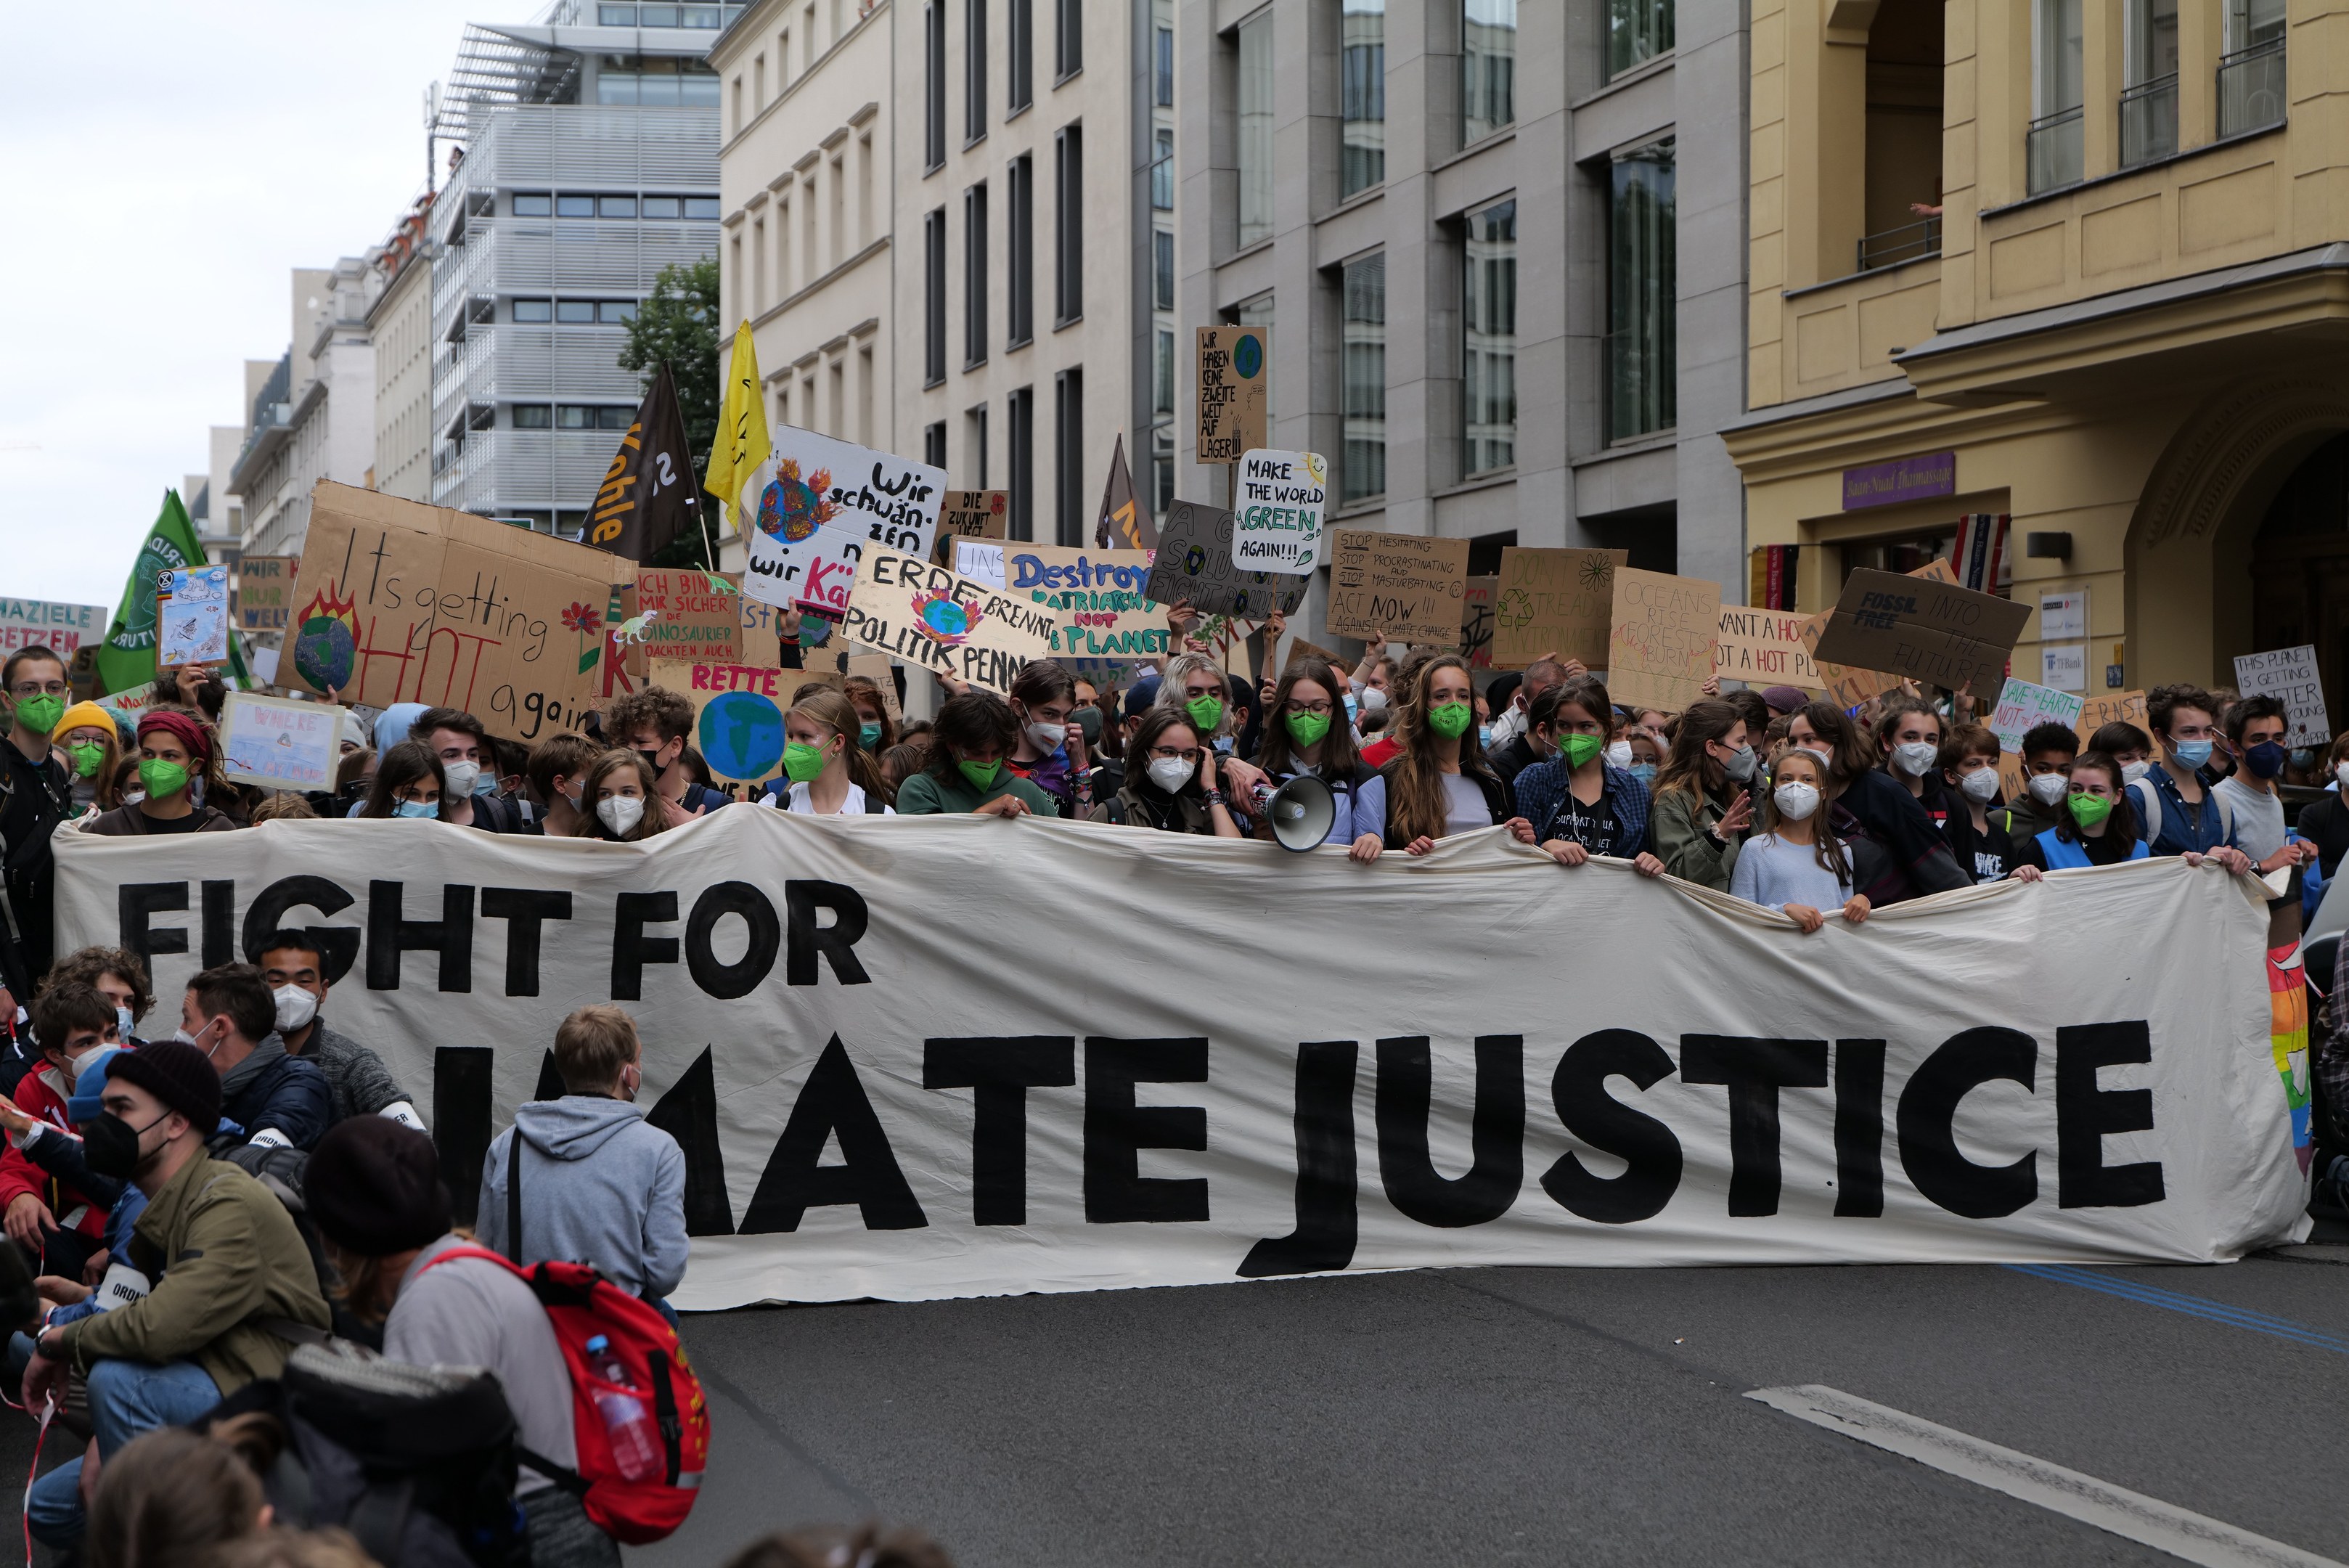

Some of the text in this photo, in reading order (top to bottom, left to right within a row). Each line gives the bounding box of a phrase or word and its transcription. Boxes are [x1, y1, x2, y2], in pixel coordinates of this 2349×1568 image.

[1202, 332, 1217, 348] WIR
[1202, 350, 1229, 369] HABEN
[1202, 369, 1223, 386] KEINE
[1202, 385, 1235, 402] ZWEITE
[1202, 403, 1225, 419] WELT
[1201, 419, 1219, 436] AUF
[1200, 437, 1241, 461] LAGER!!!
[1247, 459, 1291, 480] MAKE
[1846, 466, 1952, 497] Baan-Nuad Thaimassage
[872, 462, 934, 502] Wir
[1246, 482, 1323, 505] THE WORLD
[963, 492, 982, 509] DIE
[949, 511, 990, 525] ZUKUNFT
[1167, 505, 1194, 536] A
[1245, 505, 1315, 531] GREEN
[958, 526, 983, 536] LIEGT
[1341, 534, 1432, 552] STOP HESITATING
[1240, 540, 1297, 560] AGAIN!!!
[243, 560, 280, 579] WIR
[750, 547, 800, 580] wir
[1011, 554, 1152, 595] Destroy
[1339, 552, 1455, 573] STOP PROCRASTINATING
[1391, 567, 1408, 576] AND
[638, 574, 709, 595] ICH BIN
[873, 556, 989, 605] ERDE
[1147, 569, 1222, 611] FIGHT
[1339, 572, 1445, 592] STOP MASTURBATING
[242, 587, 282, 605] NUR
[639, 596, 732, 615] MIR SICHER,
[1332, 592, 1365, 614] ACT
[1370, 595, 1417, 621] NOW
[1464, 588, 1487, 601] rn
[1535, 592, 1596, 618] TREAD
[1625, 581, 1712, 614] OCEANS
[410, 571, 547, 662] getting
[983, 595, 1055, 640] BRENNT
[1074, 613, 1118, 628] NOT
[1648, 608, 1690, 630] RISE
[1860, 592, 1981, 626] FOSSIL INTO
[642, 623, 731, 642] DINOSAURIER
[842, 606, 959, 671] POLITIK
[1063, 626, 1171, 654] PLANET
[1335, 616, 1452, 640] AGAINST CLIMATE CHANGE
[1627, 621, 1707, 653] FORESTS
[1762, 617, 1774, 640] A
[1852, 610, 1899, 629] FREE
[1945, 627, 1989, 657] THE
[645, 644, 735, 659] DACHTEN AUCH,
[1646, 645, 1688, 667] BURN
[1716, 645, 1734, 667] OT
[1741, 648, 1750, 669] A
[1757, 648, 1789, 673] HOT
[2234, 646, 2313, 671] THIS PLANET
[1891, 642, 1992, 686] FUTURE
[692, 665, 781, 696] RETTE
[2240, 666, 2310, 687] IS GETTING
[491, 685, 592, 739] again
[2001, 681, 2082, 719] SAVE THE EARTH
[256, 707, 317, 731] WHERE
[1995, 704, 2025, 729] NOT
[2021, 716, 2030, 727] THE
[2083, 695, 2144, 730] ERNST
[292, 762, 327, 783] HOME
[118, 874, 871, 1001] FIGHT FOR
[1235, 1019, 2166, 1278] JUSTICE
